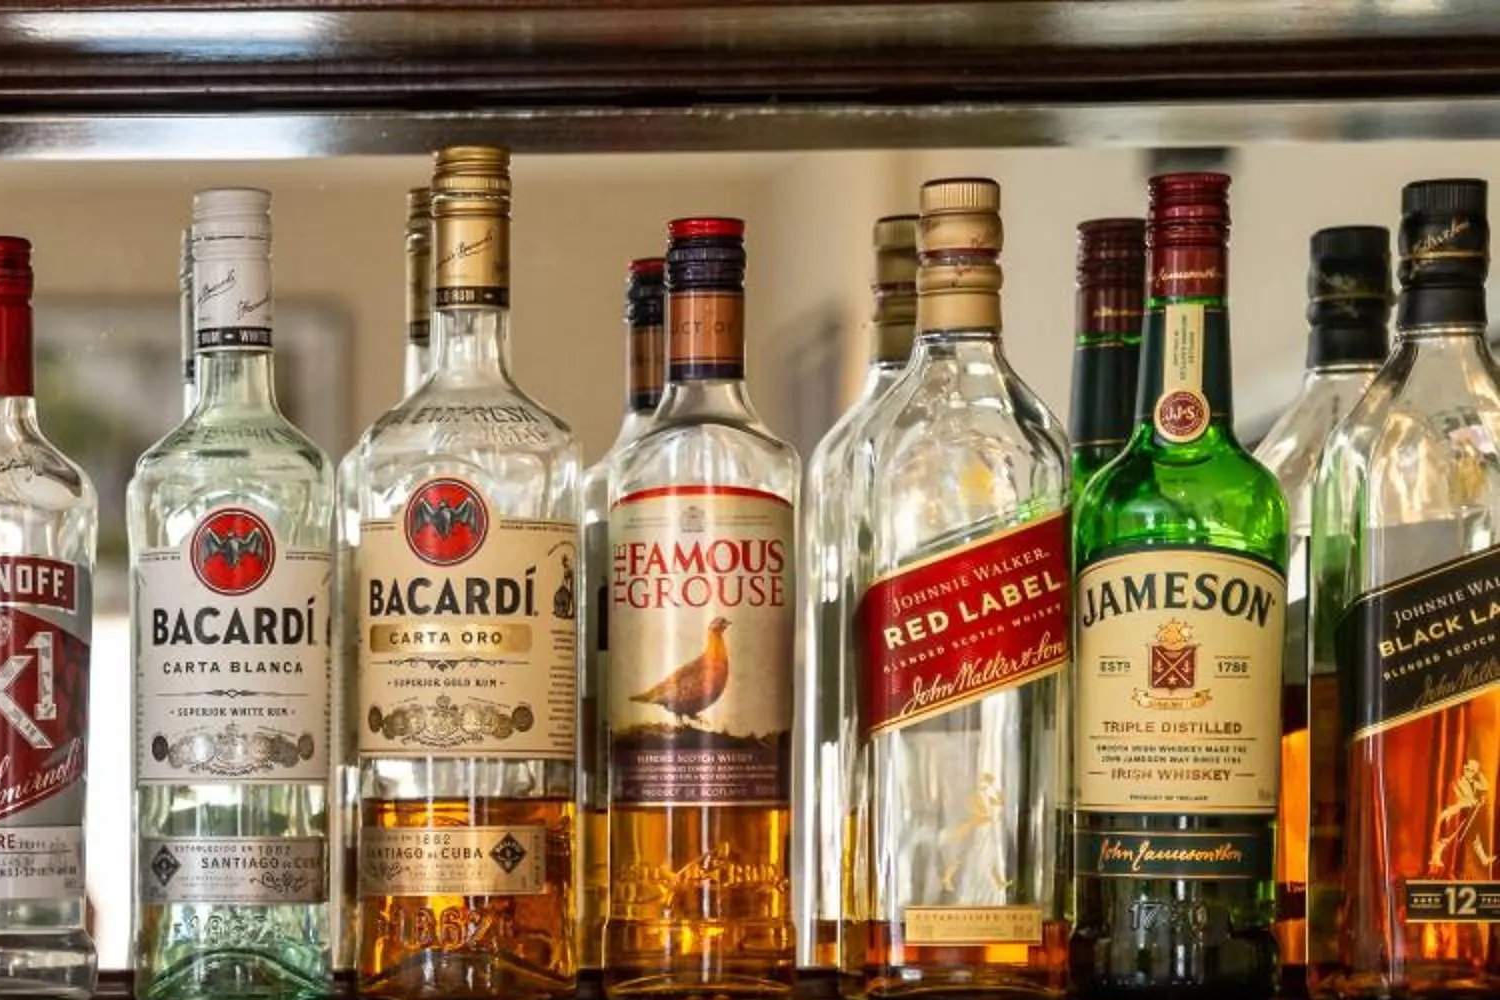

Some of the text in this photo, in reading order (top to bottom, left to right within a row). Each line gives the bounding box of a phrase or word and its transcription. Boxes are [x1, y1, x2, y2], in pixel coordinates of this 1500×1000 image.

[628, 538, 785, 577] FAMOUS
[369, 565, 537, 617] BACARDÍ
[627, 575, 785, 609] GROUSE
[891, 547, 1044, 616] JOHNNIE WALKER
[883, 570, 1063, 651] RED LABEL
[1082, 571, 1273, 628] JAMESON
[1393, 588, 1466, 629] JOHNNIE
[153, 596, 316, 646] BACARDÍ
[952, 625, 1006, 650] SCOTCH
[1011, 602, 1063, 628] WHISKY
[1378, 614, 1465, 659] BLACK
[388, 631, 504, 646] CARTA ORO
[162, 660, 303, 674] CARTA BLANCA
[1382, 653, 1442, 682] BLENDED
[393, 679, 498, 688] SUPERIOR GOLD RUM
[177, 707, 288, 717] SUPERIOR WHITE RUM
[1102, 721, 1243, 734] TRIPLE DISTILLED
[1111, 768, 1233, 782] IRISH WHISKEY
[201, 857, 280, 869] SANTIAGO
[440, 847, 484, 860] CUBA
[1443, 886, 1478, 916] 12
